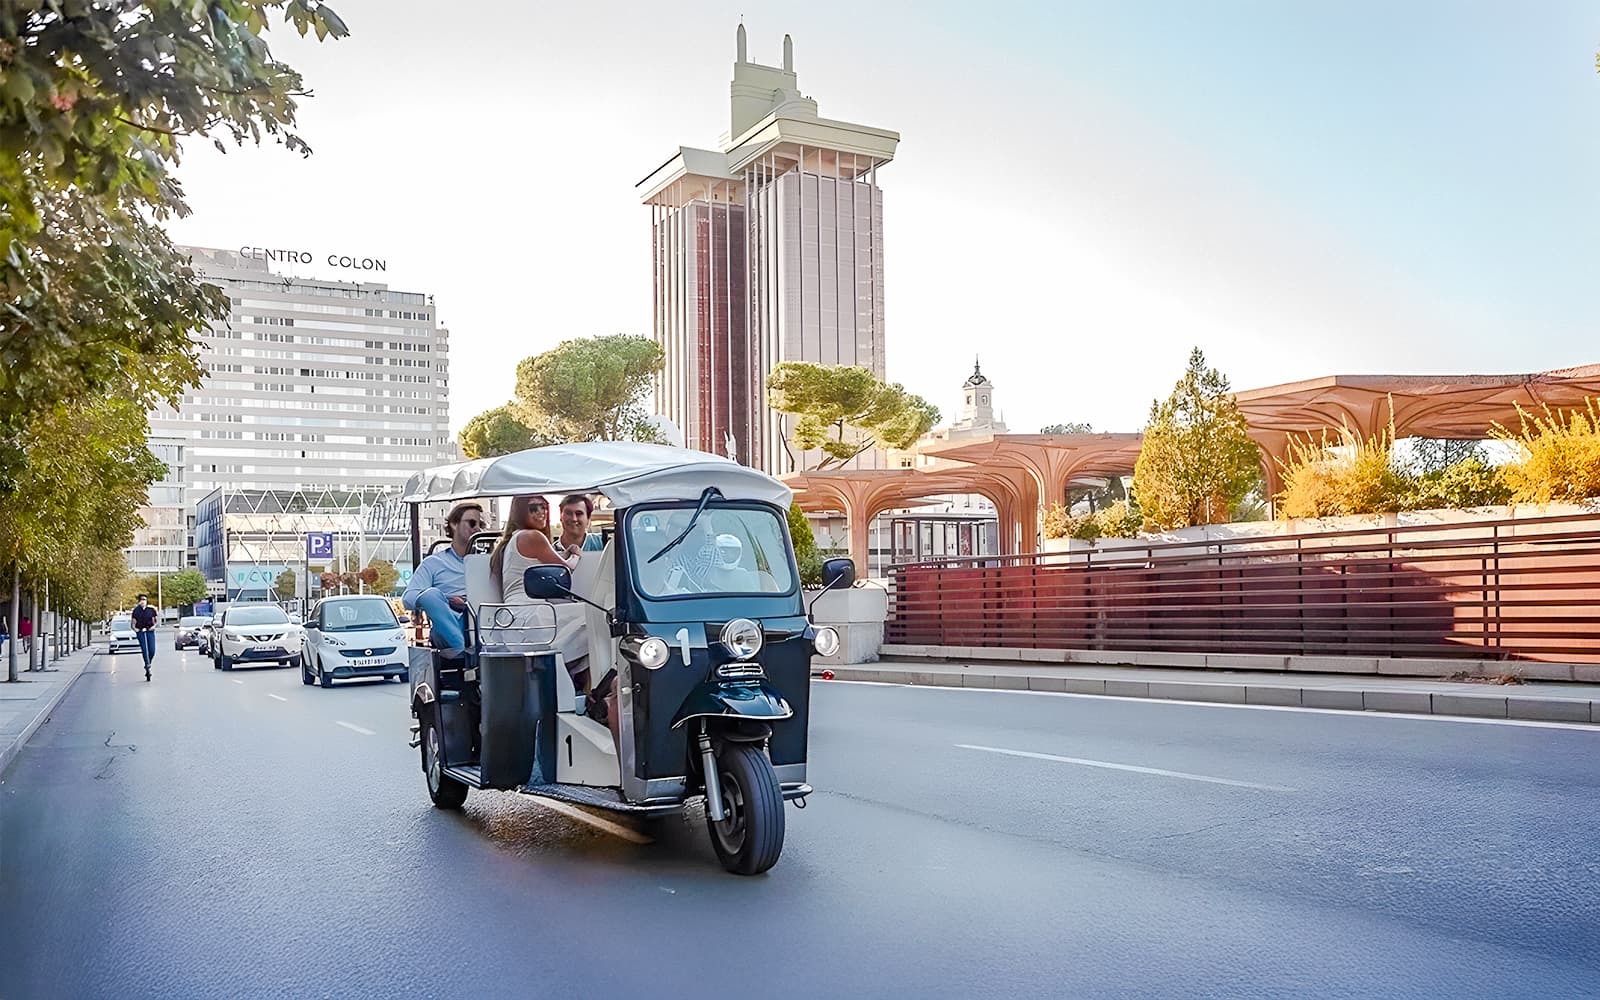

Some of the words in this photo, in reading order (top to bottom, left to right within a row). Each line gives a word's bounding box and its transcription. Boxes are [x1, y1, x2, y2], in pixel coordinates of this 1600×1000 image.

[240, 246, 312, 264] CENTRO
[327, 254, 386, 271] COLON
[311, 536, 324, 554] P
[675, 627, 691, 666] 1
[565, 734, 573, 767] 1
